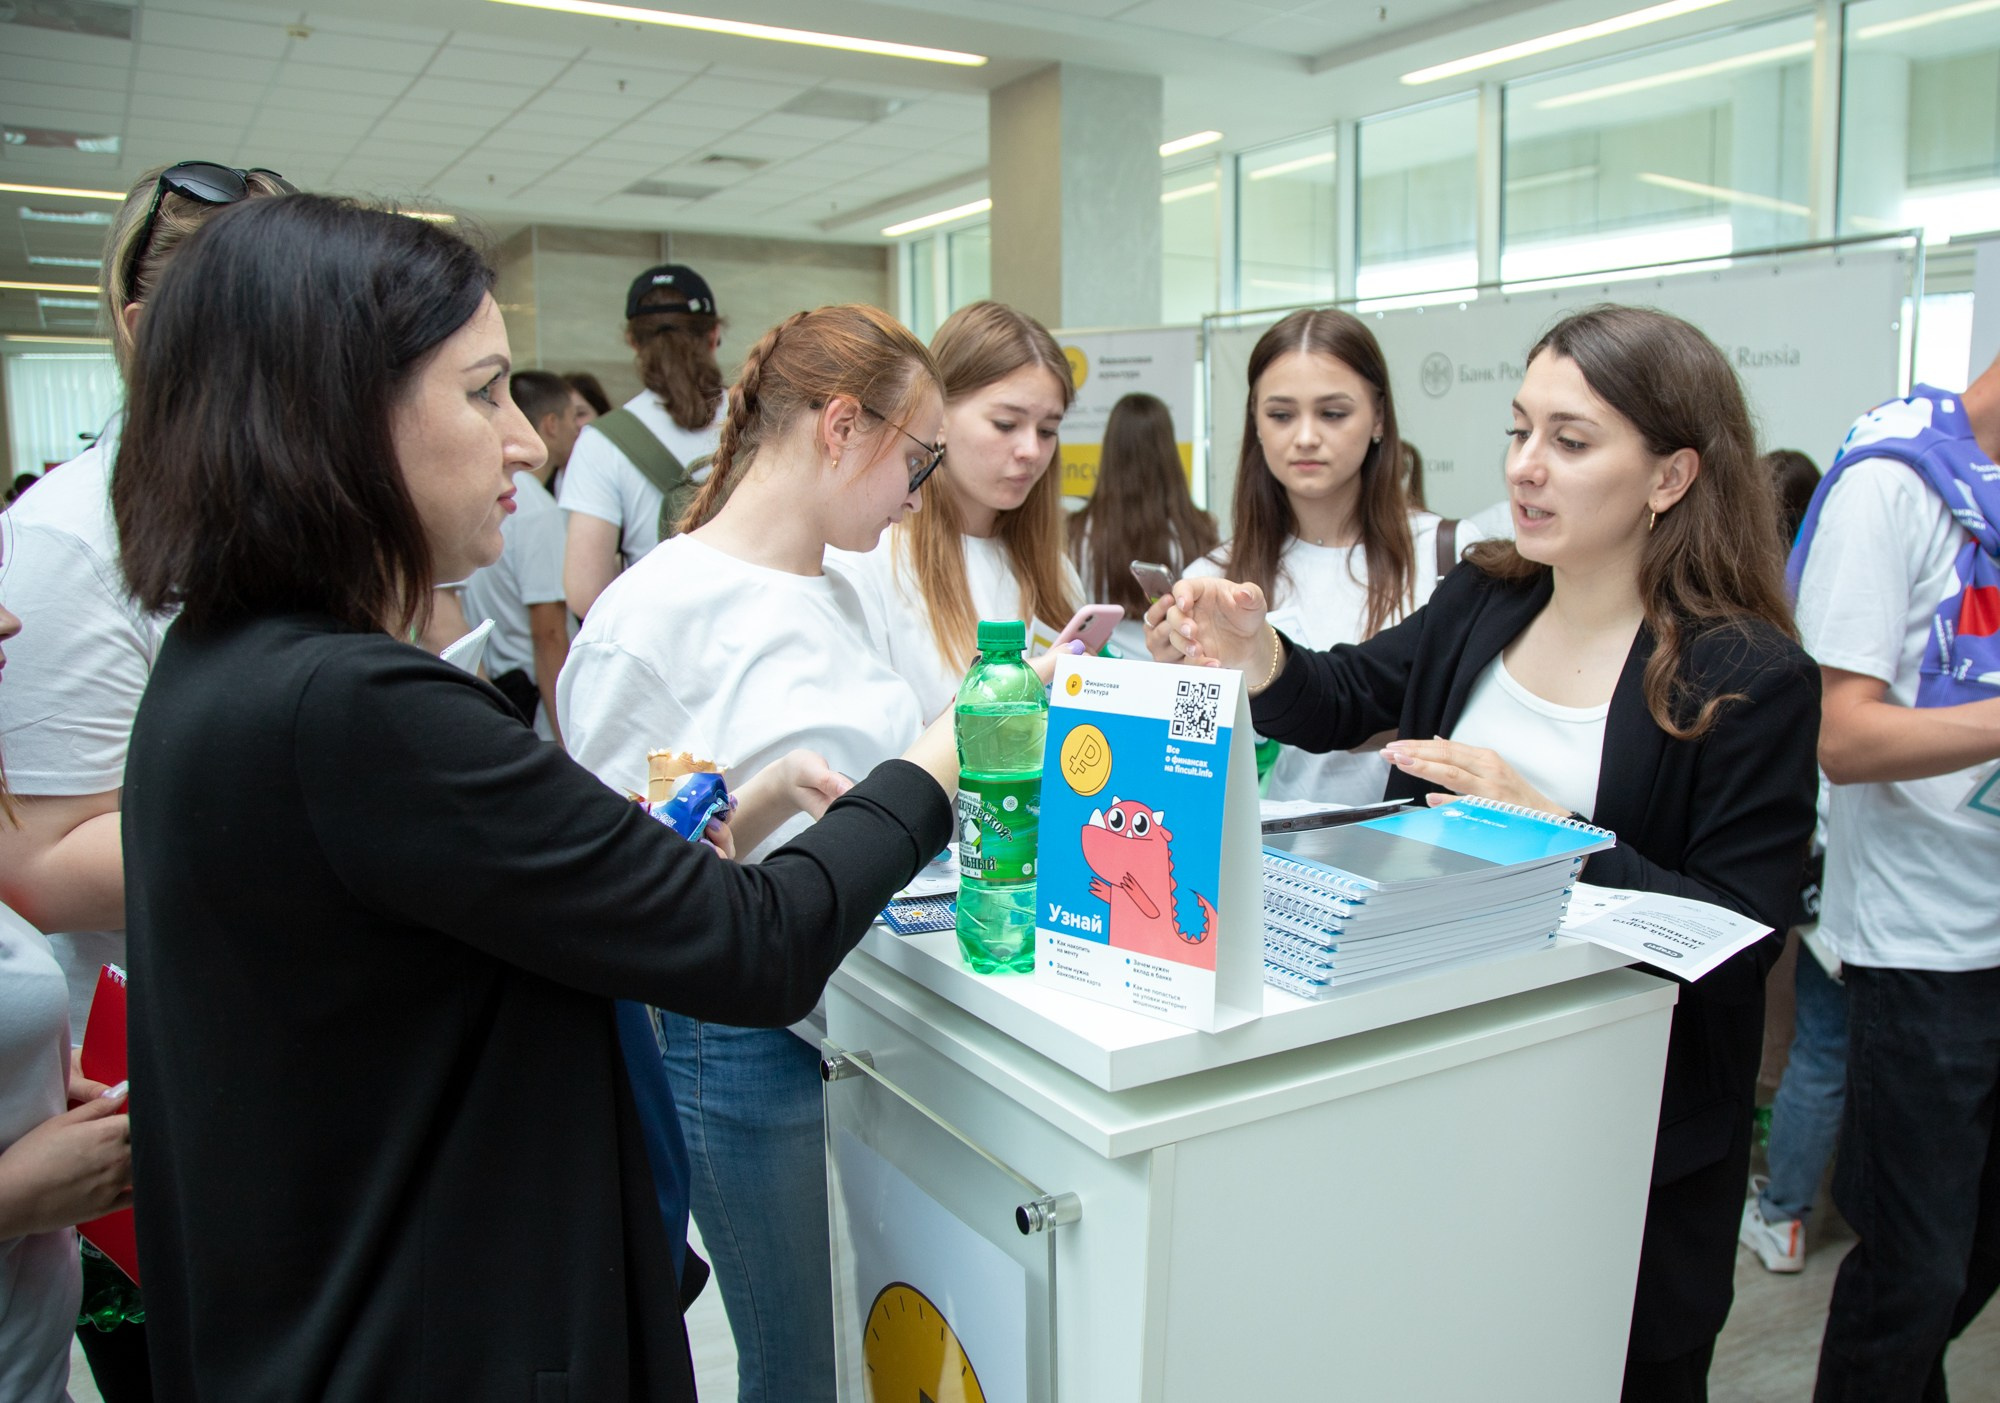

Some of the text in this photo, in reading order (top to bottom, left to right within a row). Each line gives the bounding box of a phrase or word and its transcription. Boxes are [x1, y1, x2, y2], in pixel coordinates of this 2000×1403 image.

[1736, 344, 1801, 369] Russia
[1460, 363, 1495, 382] Банк
[1084, 679, 1120, 690] Финансовая
[1083, 687, 1110, 697] культура
[1165, 745, 1181, 755] Все
[1171, 755, 1209, 768] финансах
[1164, 765, 1214, 779] на fincult.info
[1048, 902, 1103, 934] Узнай
[1612, 918, 1648, 931] карта
[1630, 917, 1706, 946] активности
[1056, 939, 1090, 953] Как накопить
[1649, 929, 1699, 950] Личная
[1064, 949, 1079, 958] мечту
[1056, 962, 1089, 976] Зачем нужна
[1133, 958, 1170, 973] Зачем нужен
[1056, 970, 1102, 988] банковская карта
[1133, 967, 1150, 977] вклад
[1155, 972, 1172, 982] банке
[1133, 983, 1143, 991] Как
